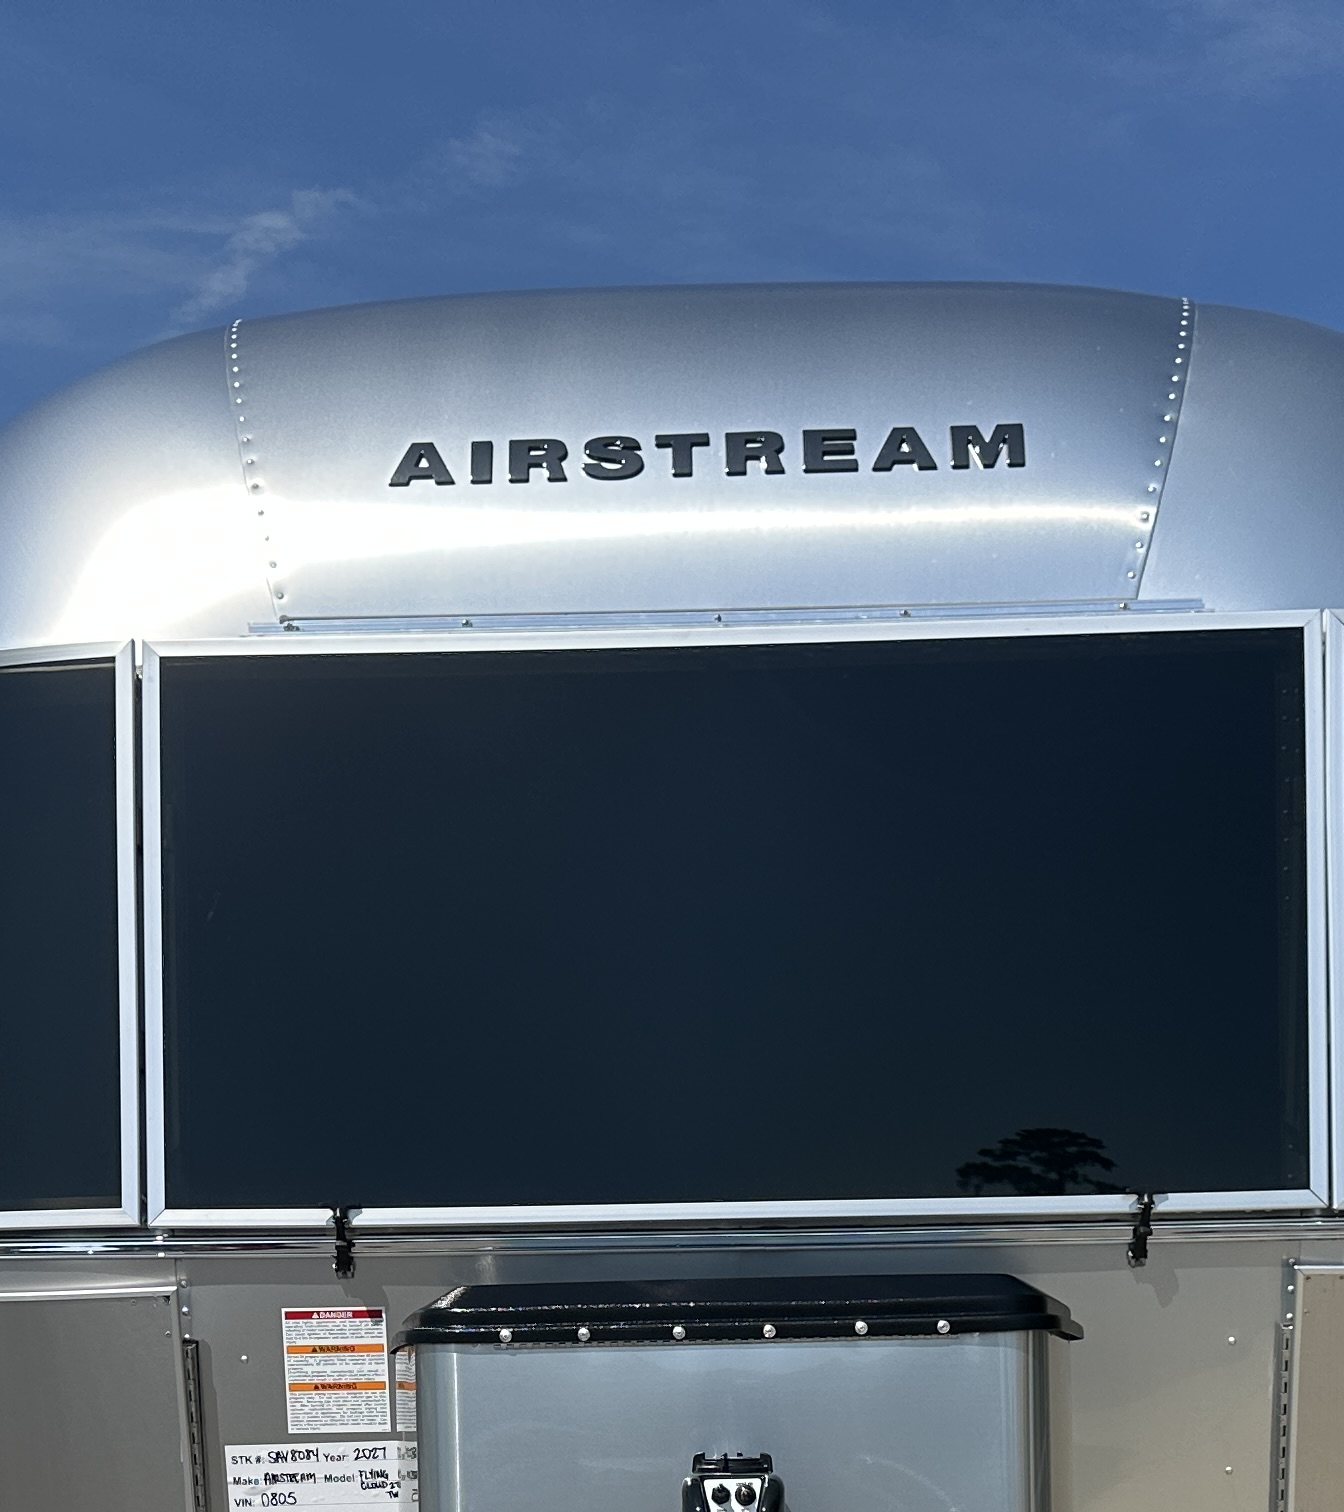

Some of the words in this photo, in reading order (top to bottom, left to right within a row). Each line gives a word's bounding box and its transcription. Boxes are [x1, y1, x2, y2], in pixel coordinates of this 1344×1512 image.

[389, 423, 1026, 487] AIRSTREAM
[319, 1311, 353, 1319] DANGER
[319, 1345, 356, 1353] WARNING
[320, 1382, 358, 1390] WARNING
[231, 1455, 253, 1465] STK
[353, 1447, 386, 1460] 2027
[261, 1492, 297, 1507] 0805
